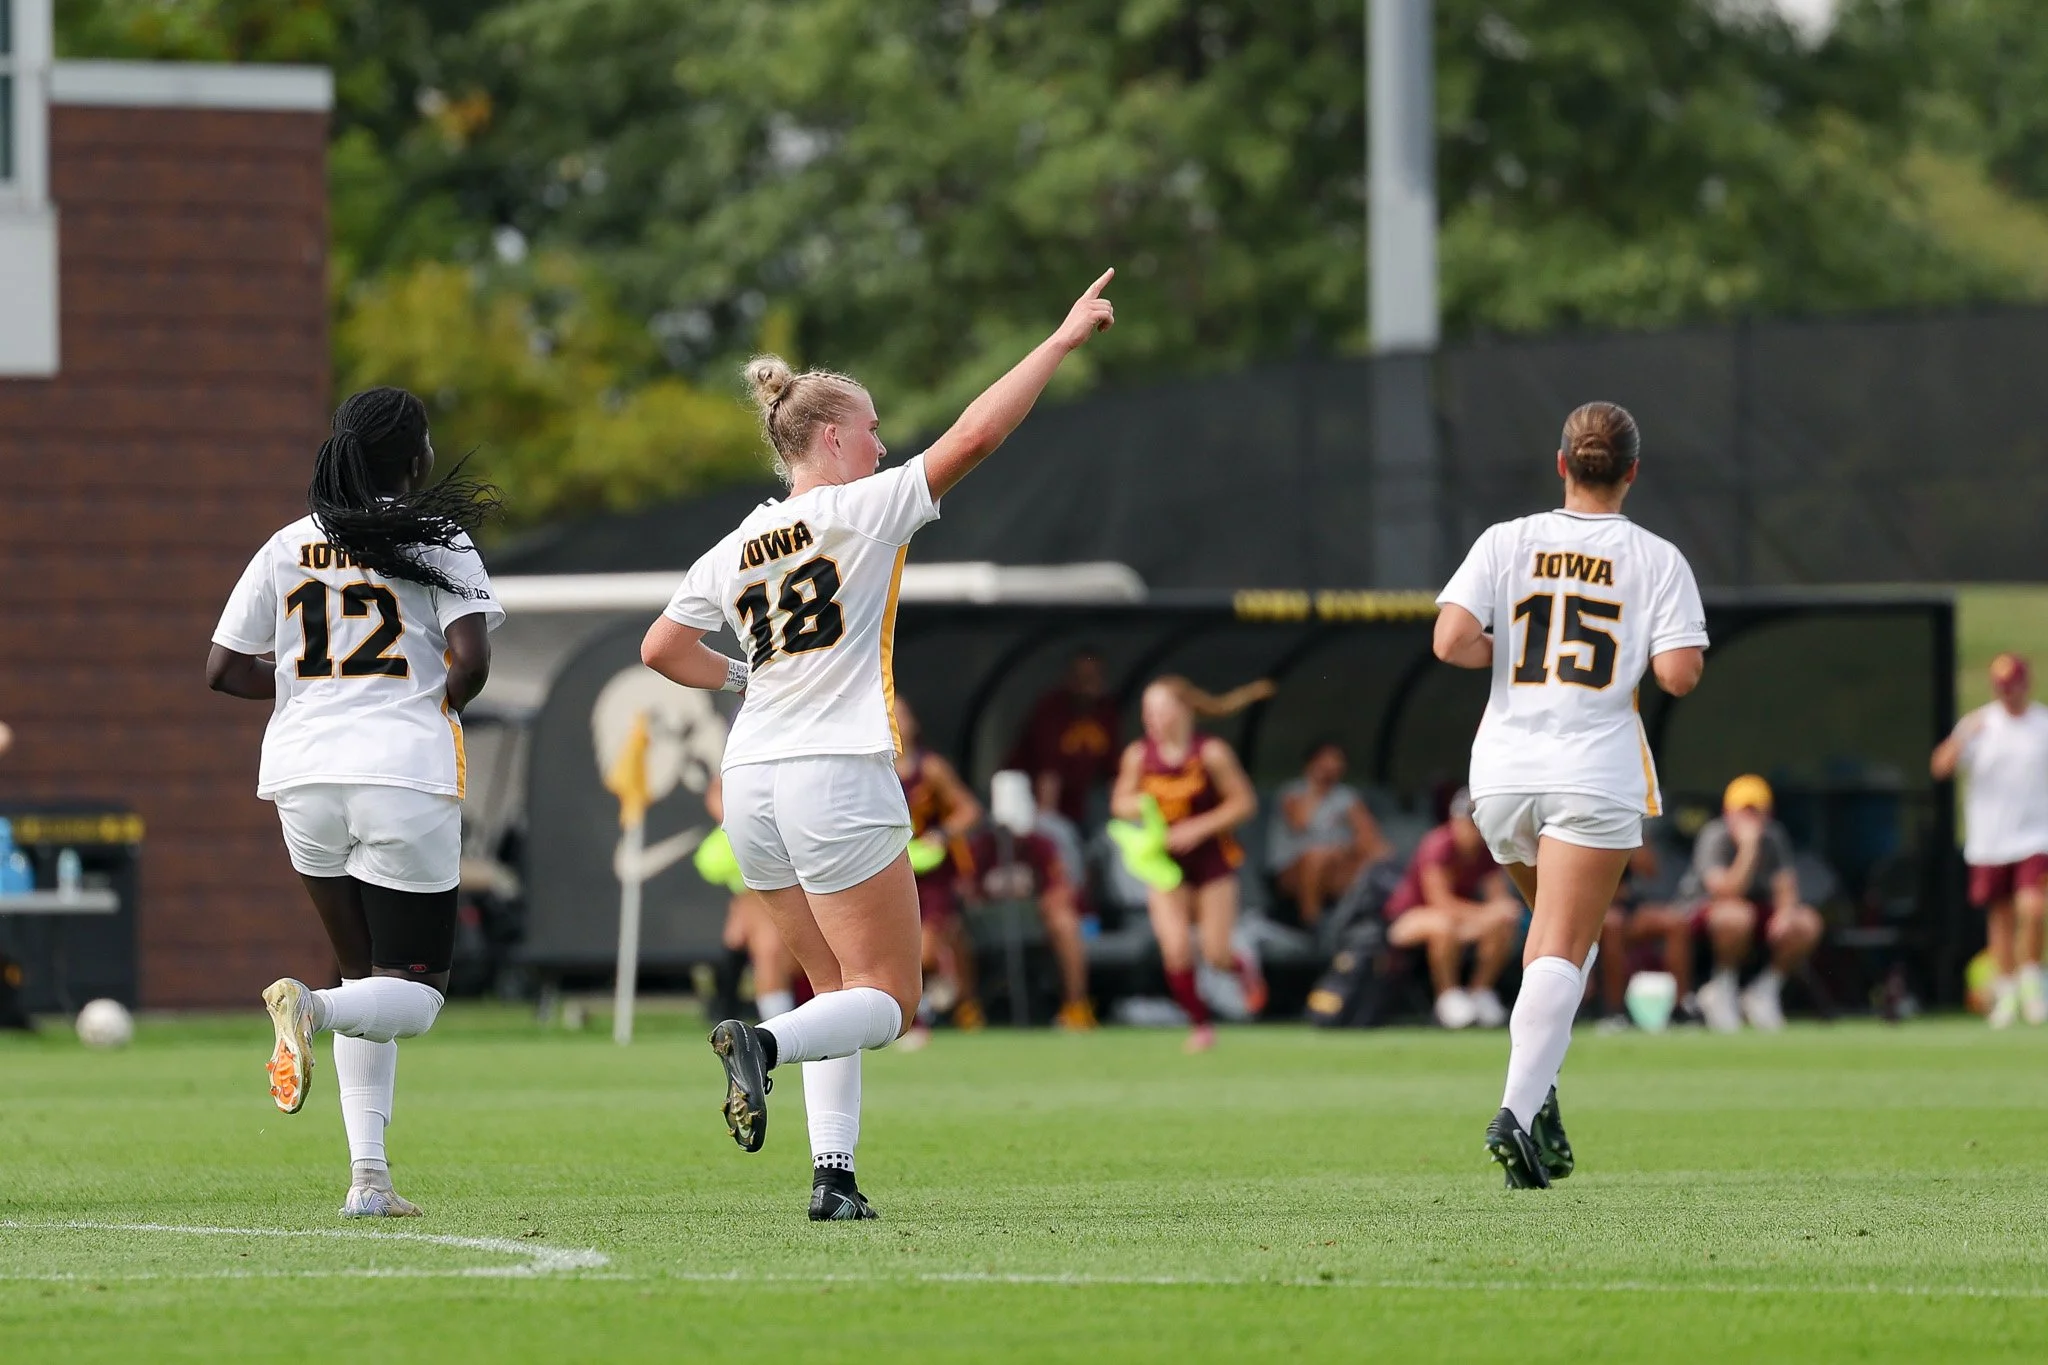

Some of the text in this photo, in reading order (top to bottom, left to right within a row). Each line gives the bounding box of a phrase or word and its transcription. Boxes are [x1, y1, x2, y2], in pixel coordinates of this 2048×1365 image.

[298, 542, 372, 570] IOW
[738, 519, 814, 571] IOWA
[1532, 552, 1615, 588] IOWA
[284, 577, 410, 680] 12
[733, 553, 847, 674] 18
[1511, 591, 1623, 691] 15
